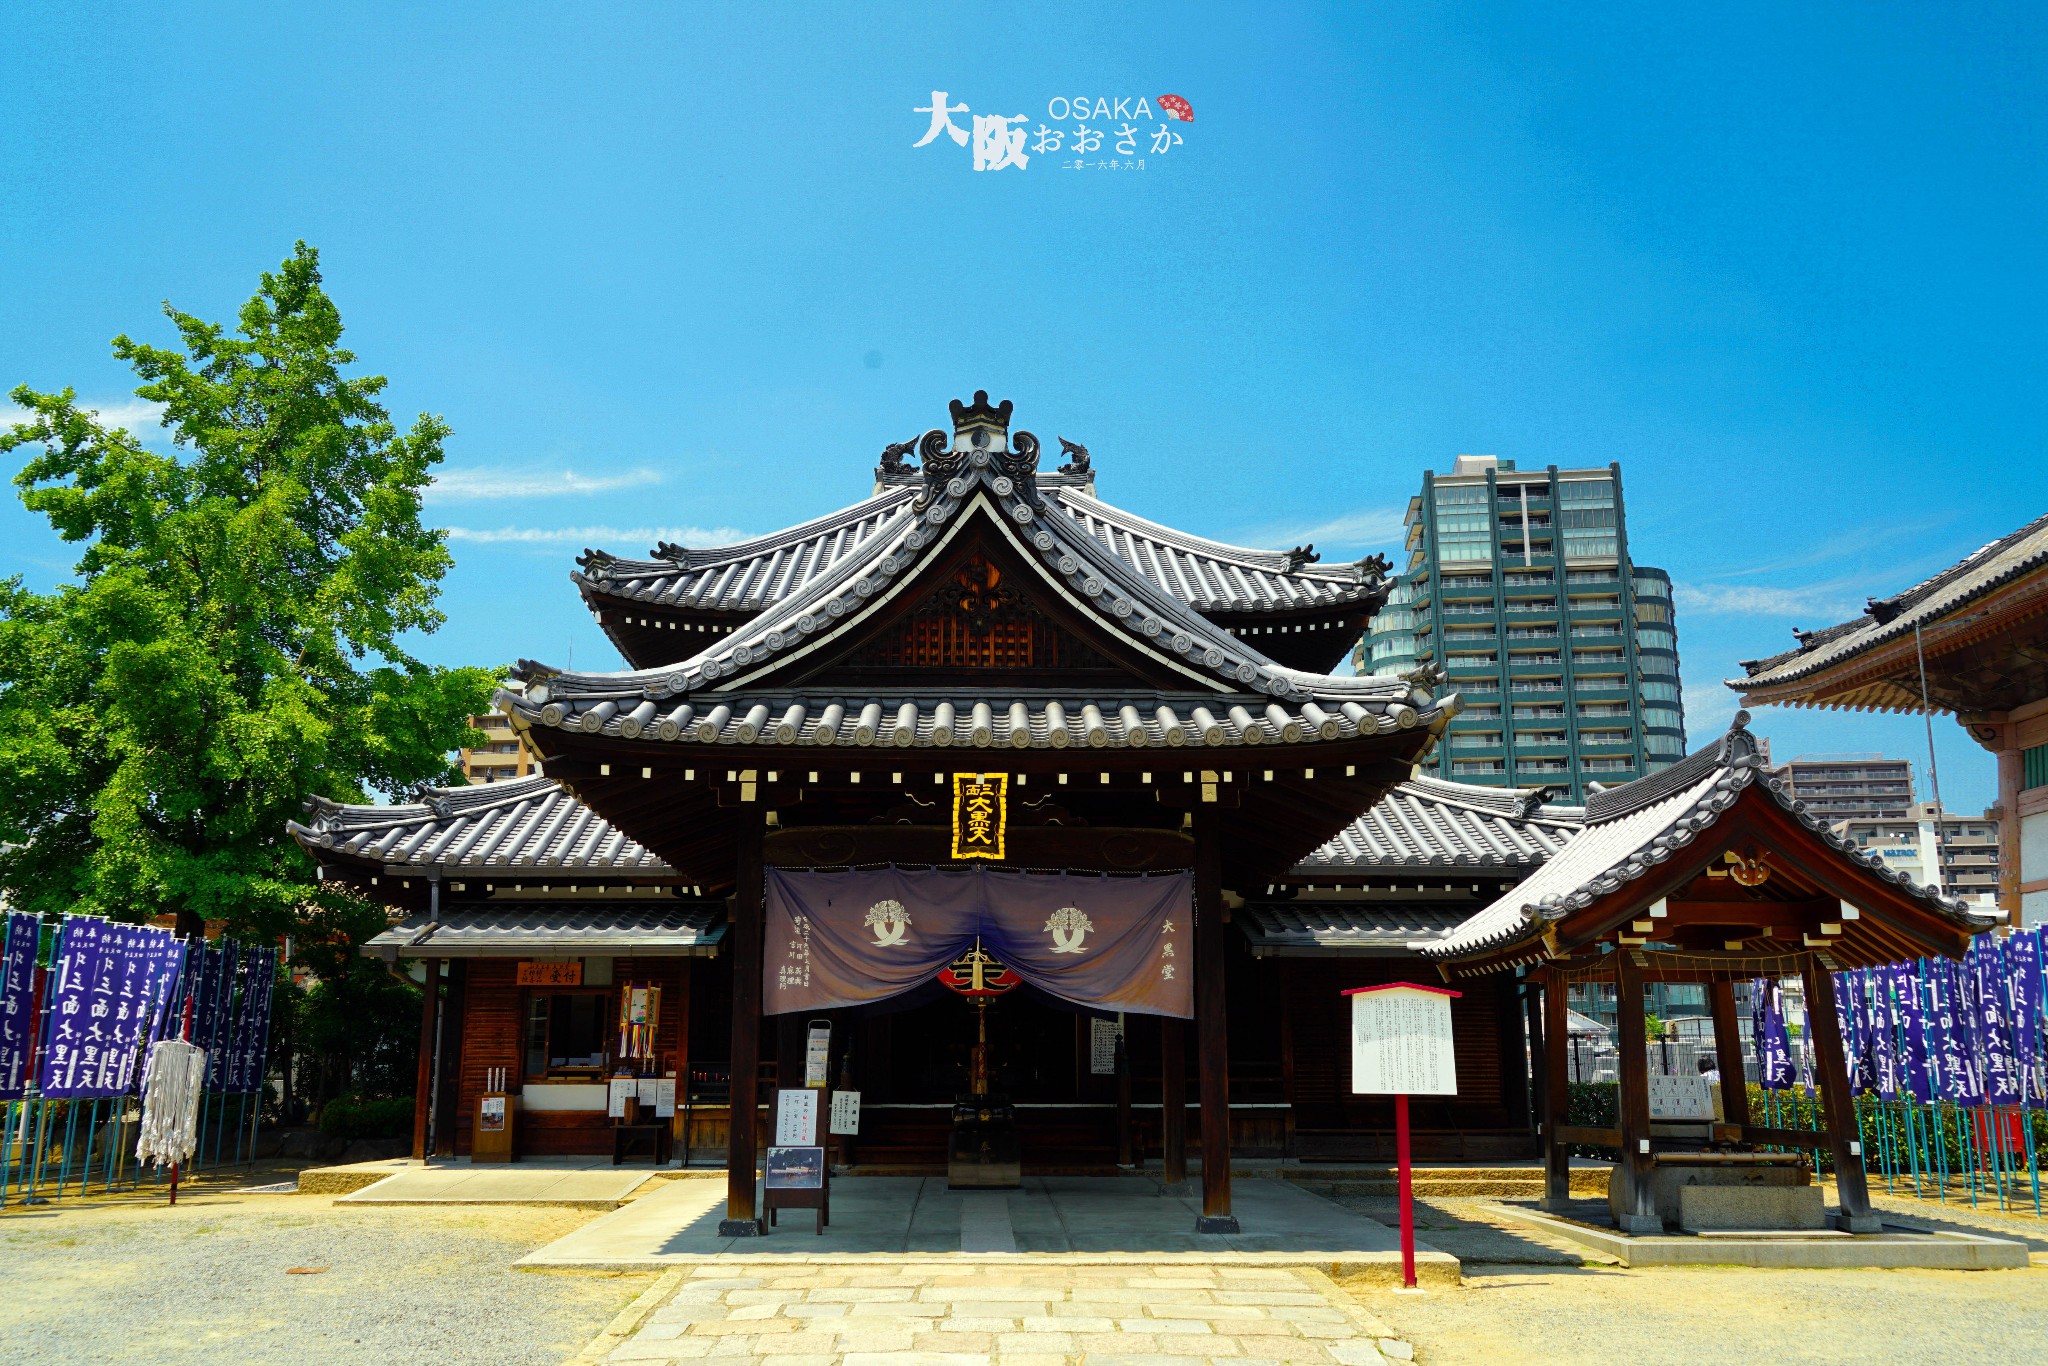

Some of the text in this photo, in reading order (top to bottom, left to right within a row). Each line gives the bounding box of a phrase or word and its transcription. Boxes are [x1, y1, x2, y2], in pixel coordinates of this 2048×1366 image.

[966, 796, 994, 845] 大黒天
[1161, 919, 1176, 980] 大黒堂
[549, 970, 576, 983] 受付
